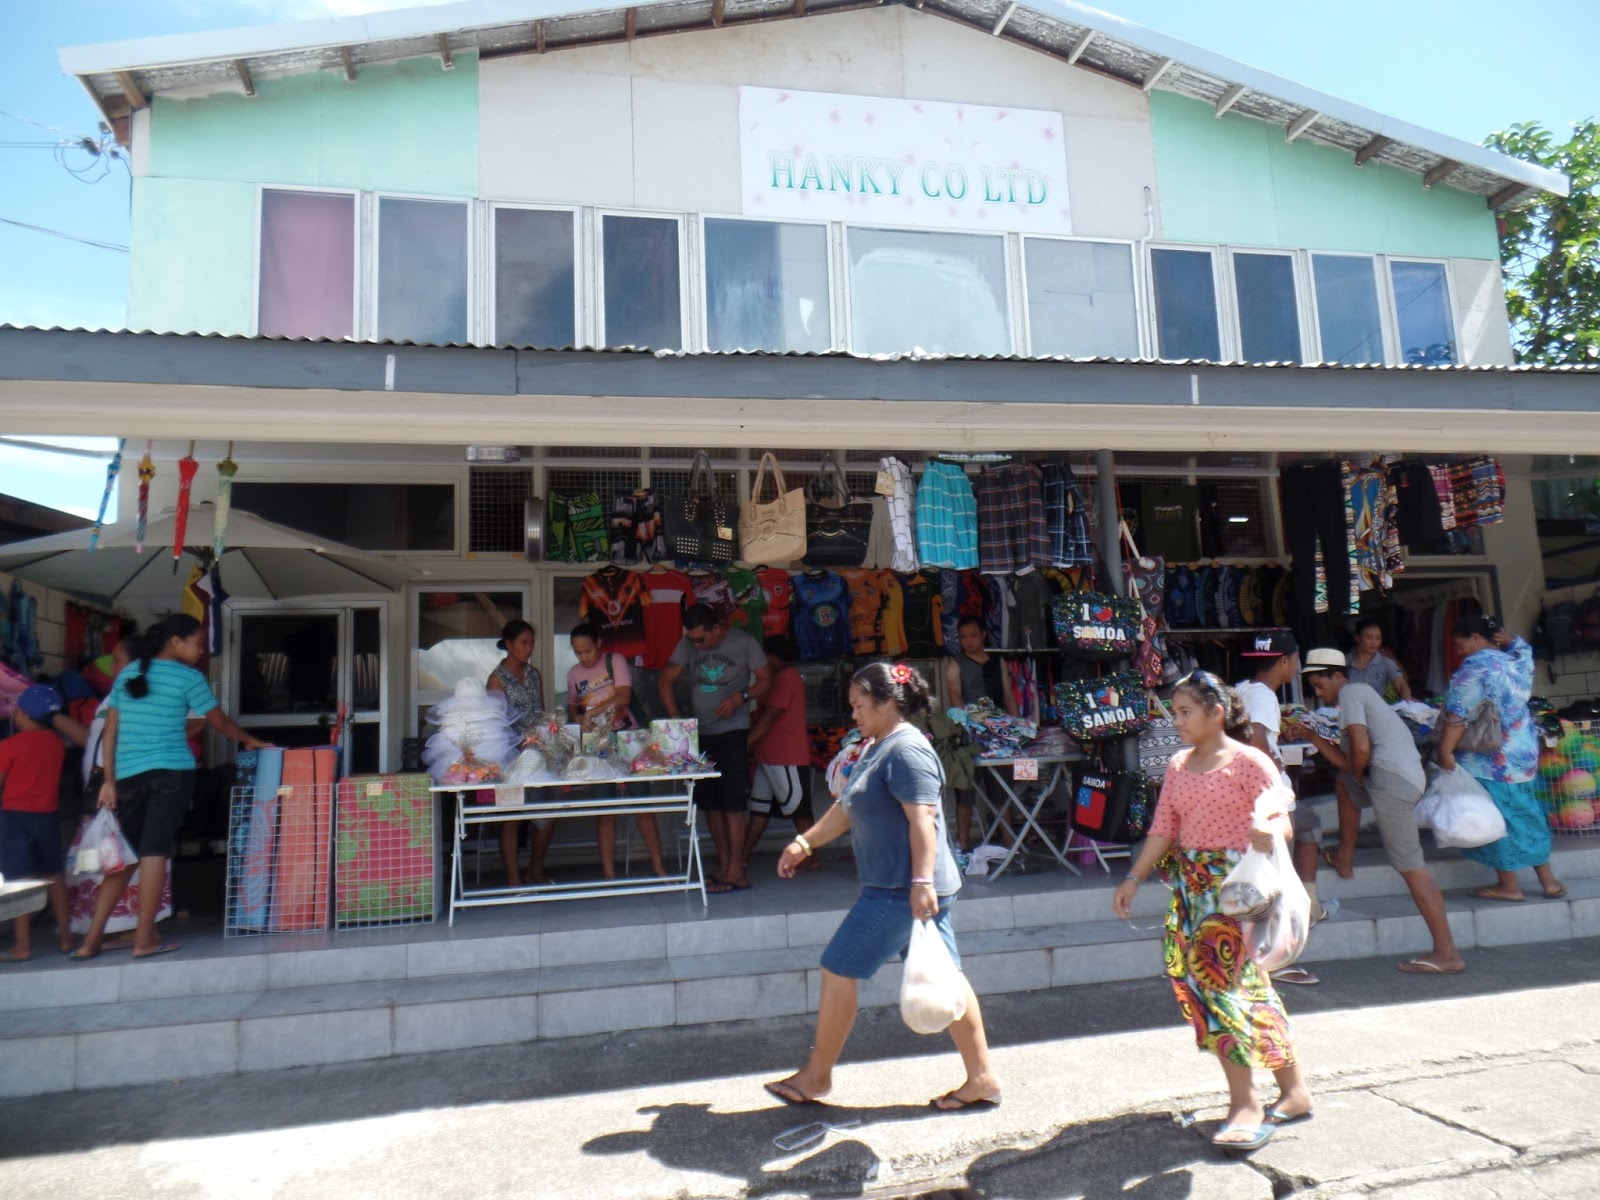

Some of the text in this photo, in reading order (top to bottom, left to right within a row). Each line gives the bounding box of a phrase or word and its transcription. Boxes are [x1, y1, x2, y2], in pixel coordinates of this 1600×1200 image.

[768, 151, 1049, 205] HANKY CO LTD
[1082, 603, 1090, 621] I
[1073, 626, 1126, 641] SMOA
[1085, 693, 1097, 709] I
[1082, 706, 1136, 729] SAMOA
[1083, 776, 1106, 789] SAMOA
